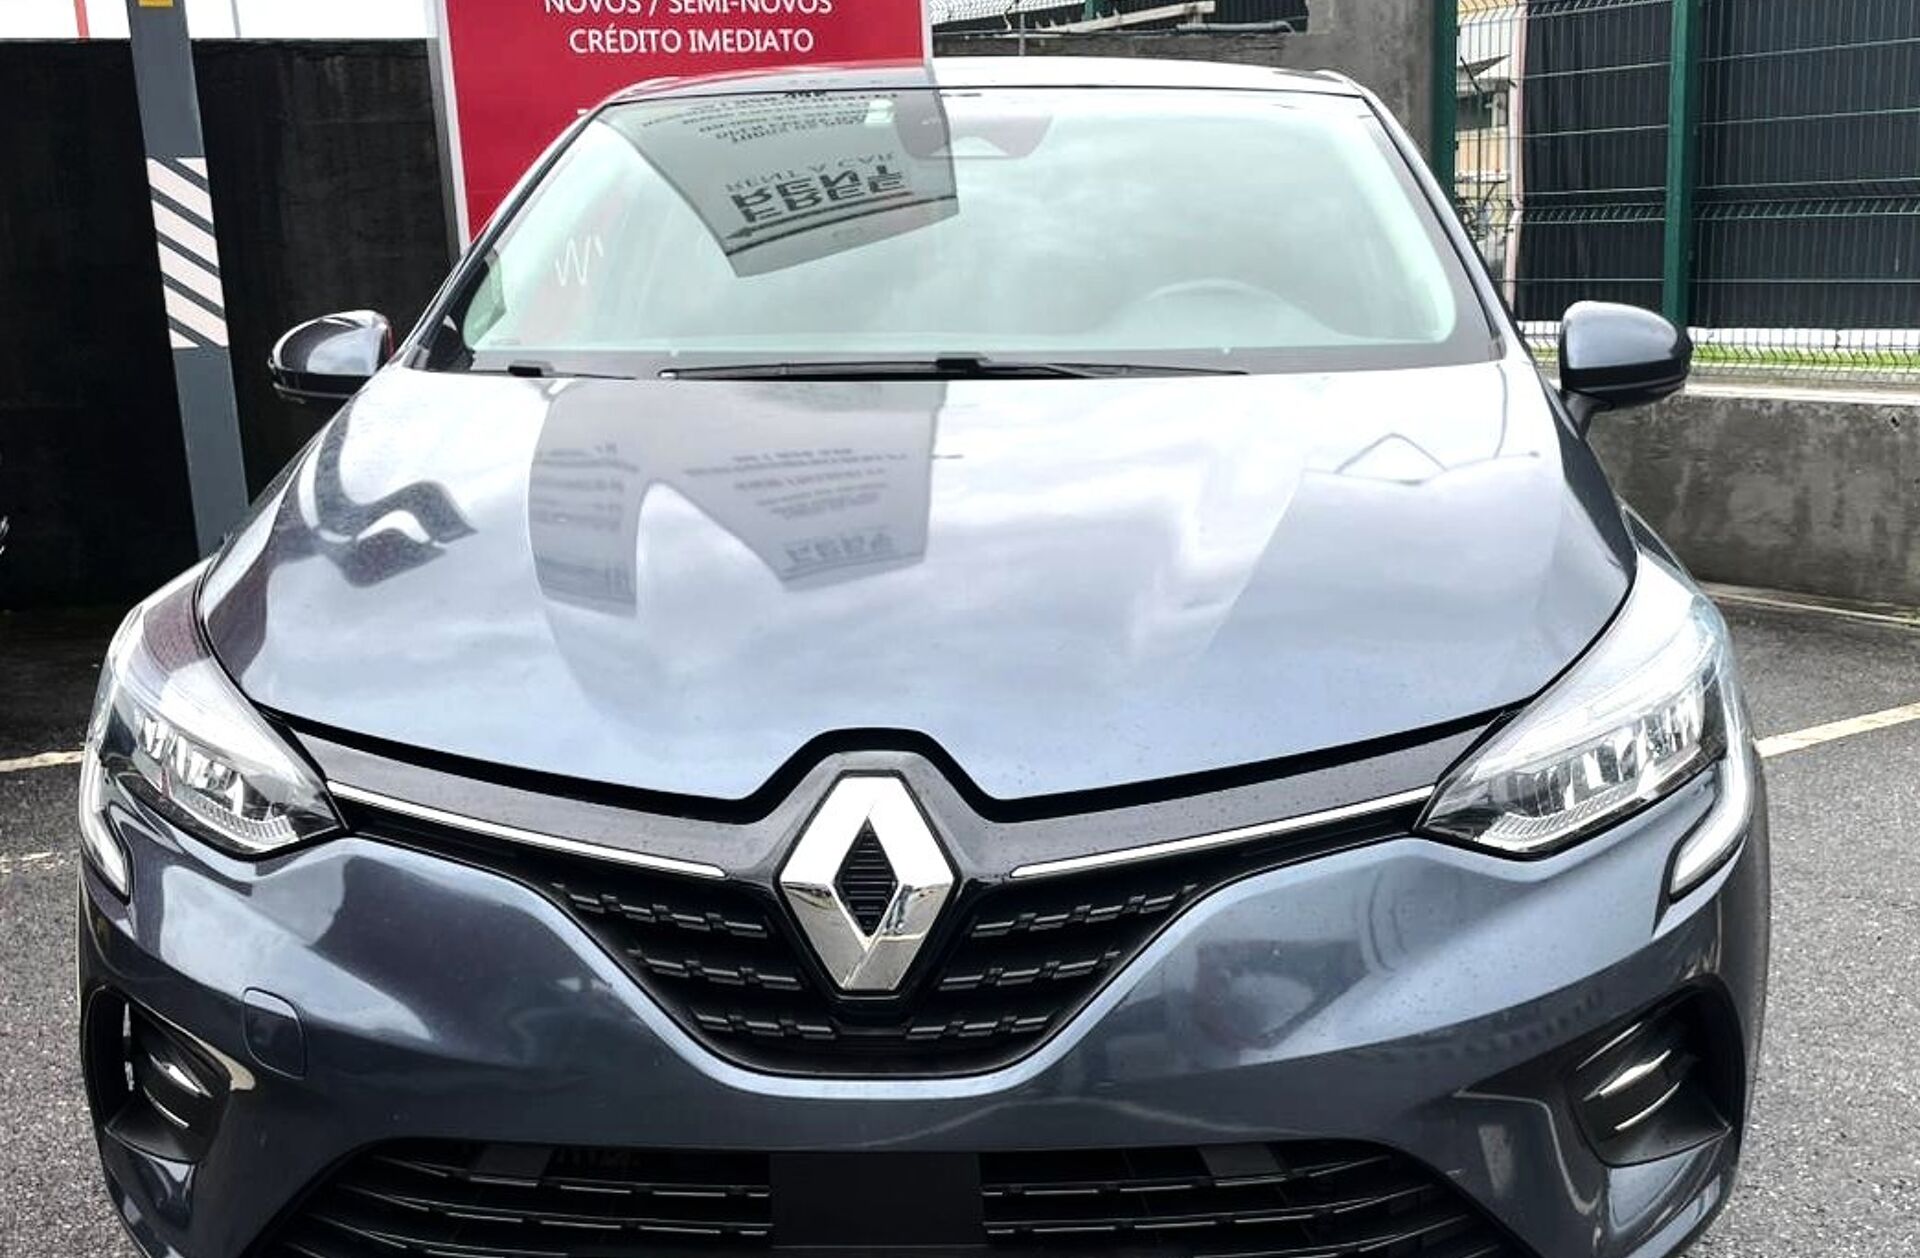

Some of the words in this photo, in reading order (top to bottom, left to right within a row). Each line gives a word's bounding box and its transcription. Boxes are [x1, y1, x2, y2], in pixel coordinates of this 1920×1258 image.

[545, 0, 642, 13] NOVOS
[668, 0, 833, 13] SEMI-NOVOS
[569, 23, 682, 53] CRÉDITO
[689, 28, 815, 53] IMEDIATO
